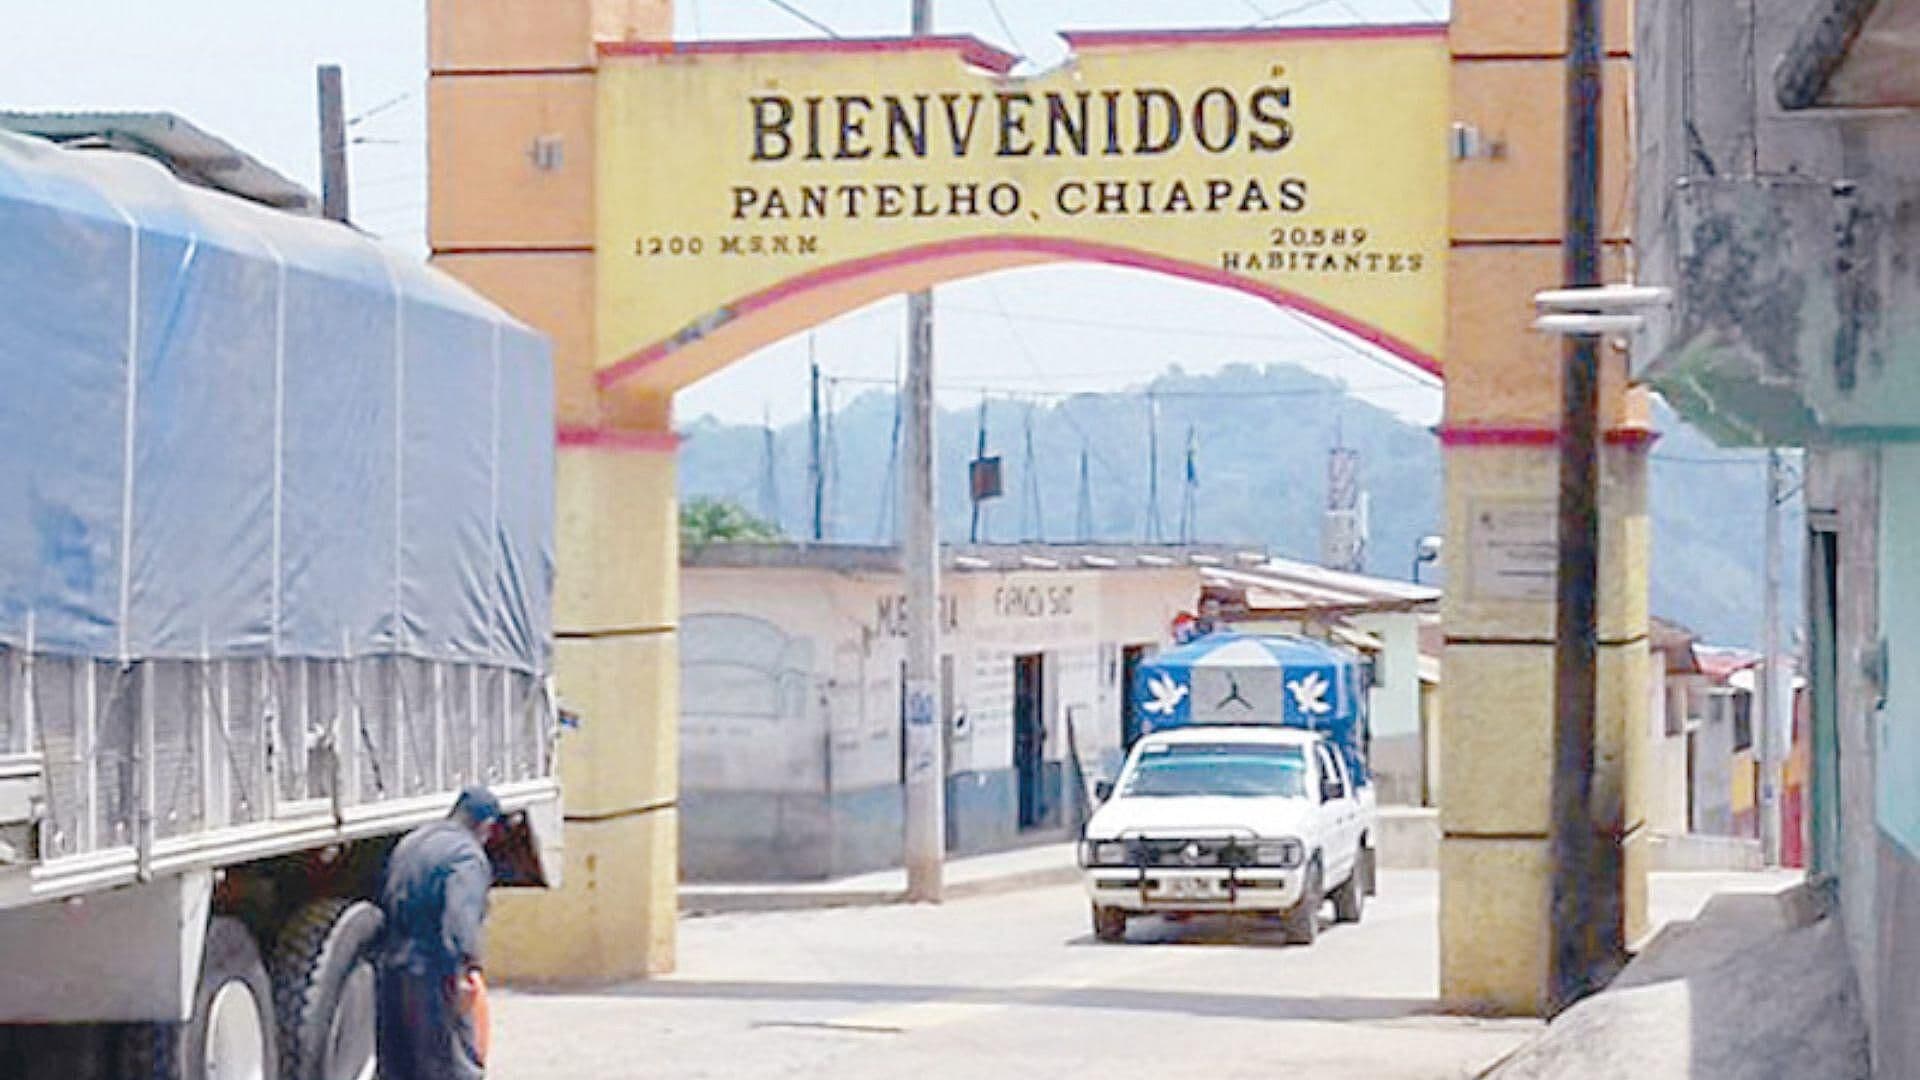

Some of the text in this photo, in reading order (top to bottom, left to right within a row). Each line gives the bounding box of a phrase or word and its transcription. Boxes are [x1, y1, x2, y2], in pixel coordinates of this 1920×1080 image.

[750, 86, 1293, 161] BIENVENIDOS
[1056, 178, 1308, 215] CHIAPAS
[634, 236, 704, 257] 1200
[1222, 251, 1424, 272] HABITANTES
